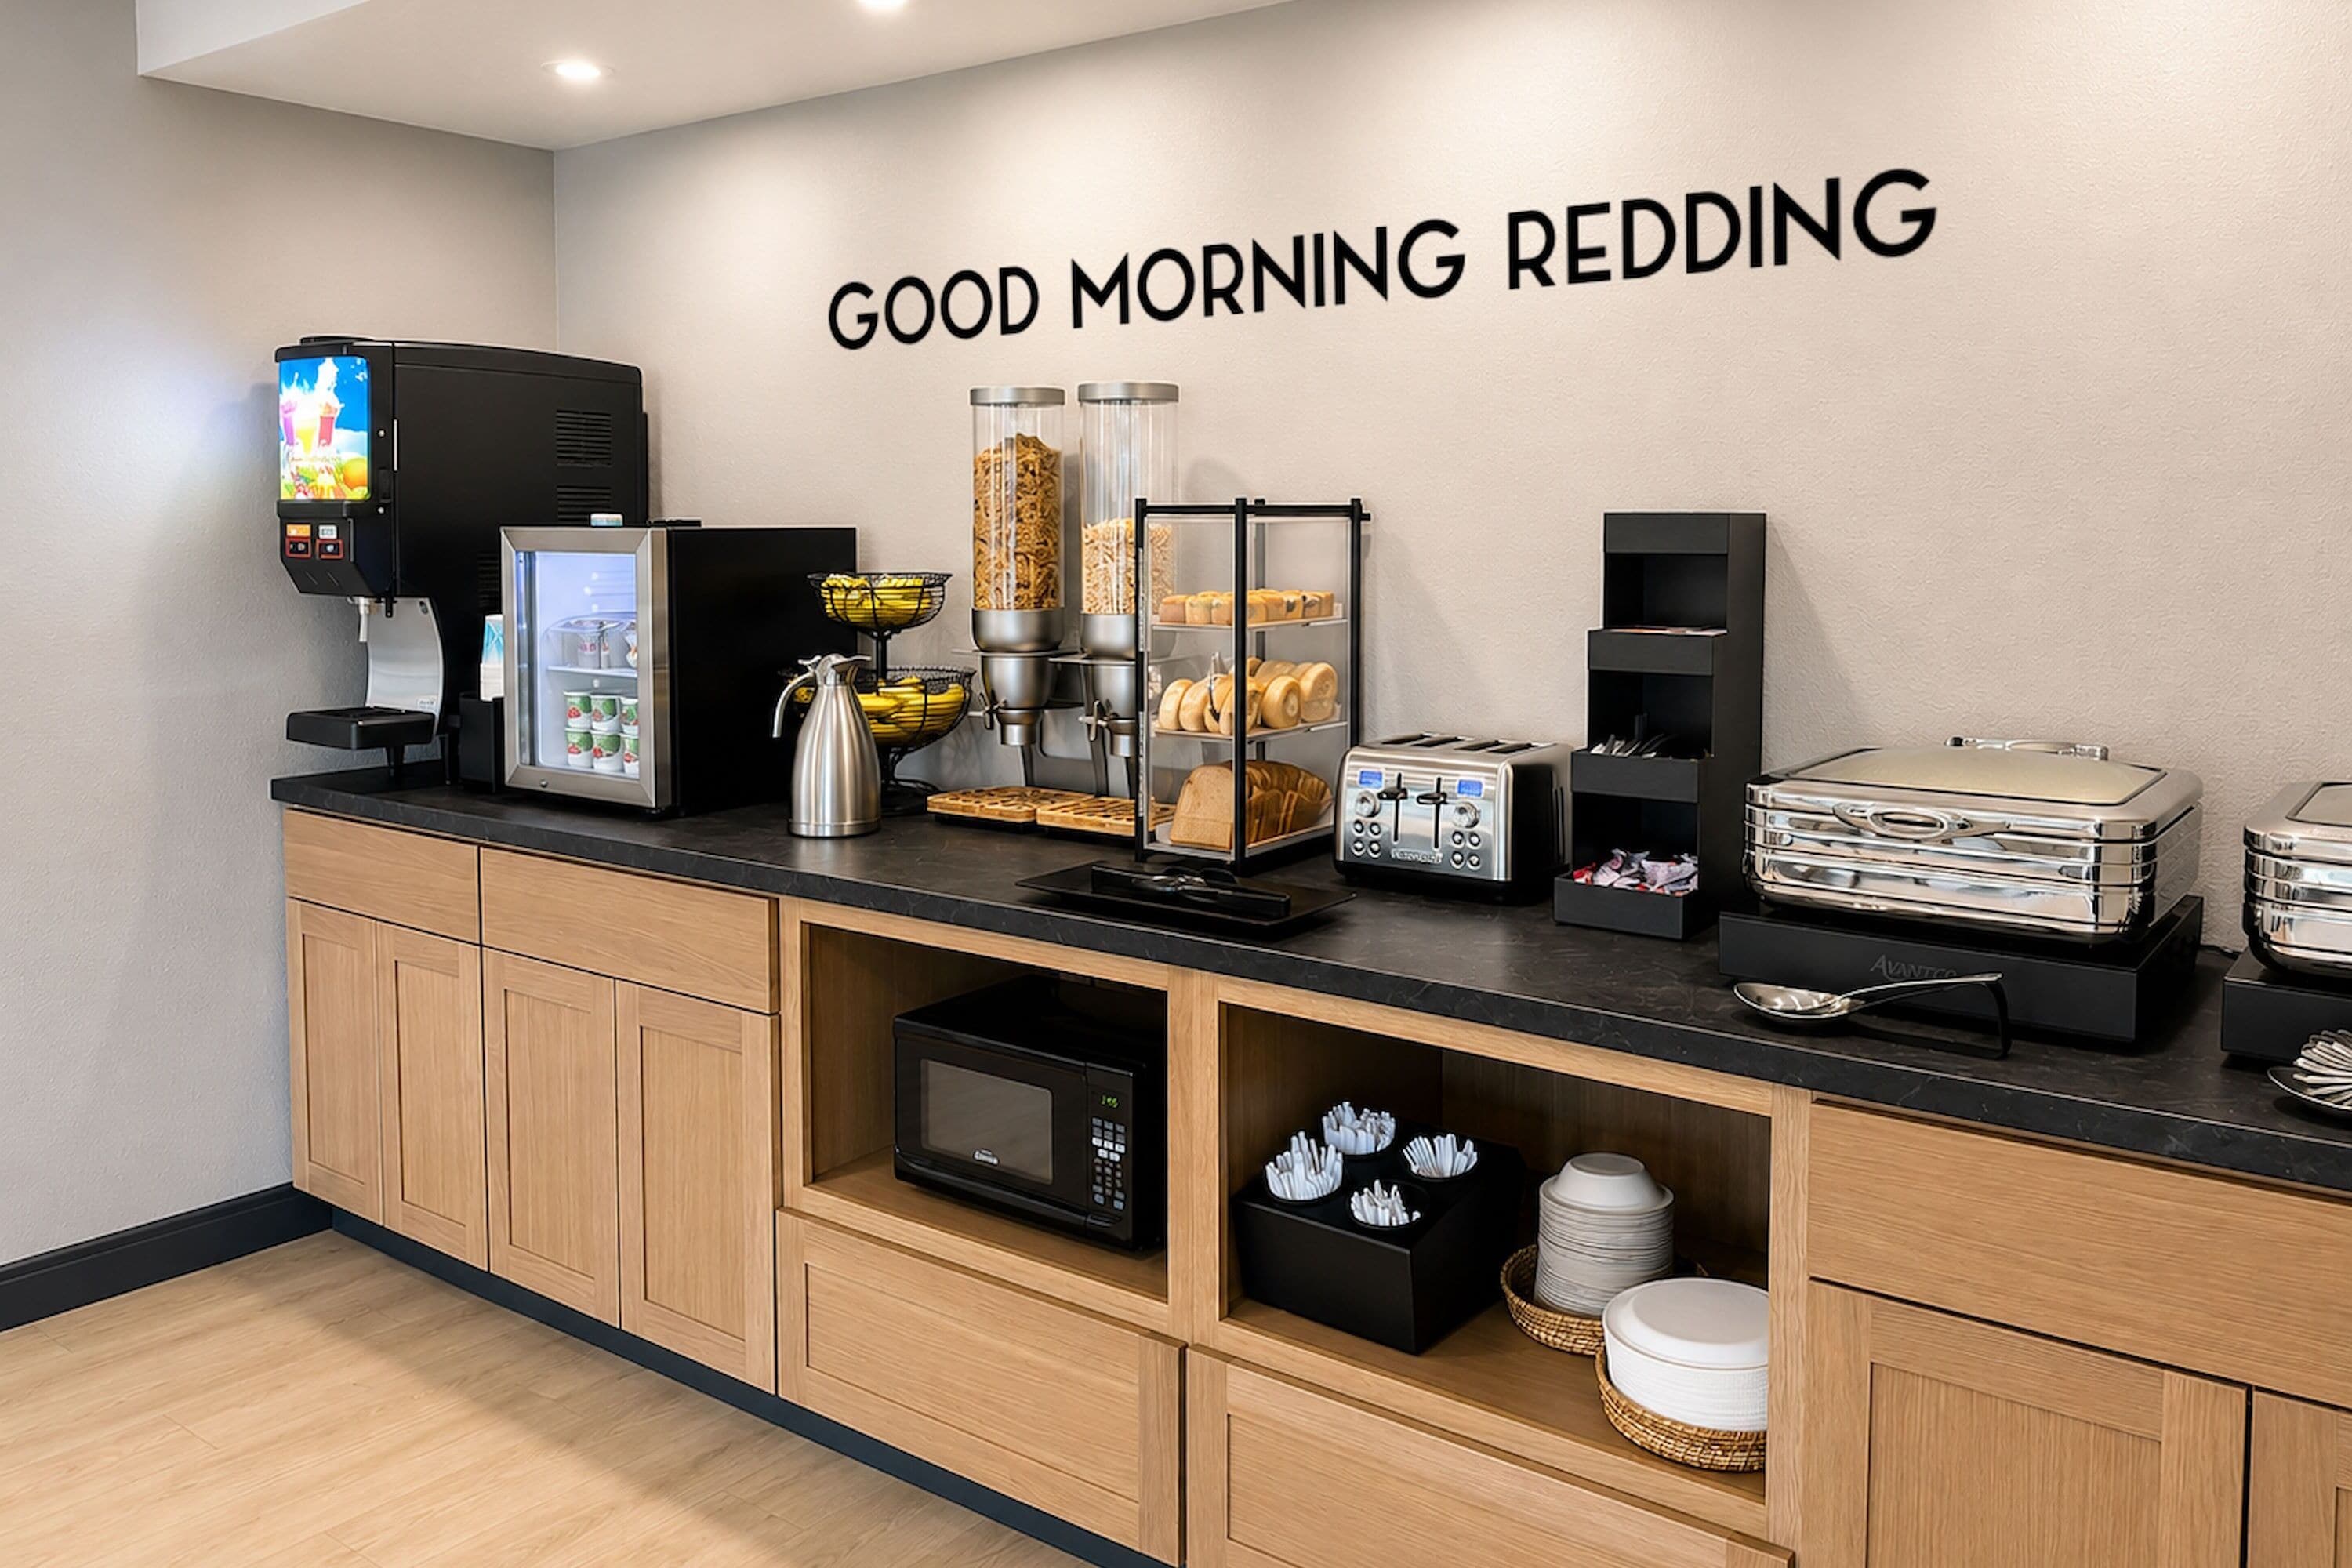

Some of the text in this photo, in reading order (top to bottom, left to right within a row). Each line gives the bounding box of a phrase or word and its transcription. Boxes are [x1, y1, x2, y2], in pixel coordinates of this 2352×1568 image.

[828, 169, 1936, 350] GOOD MORNING REDDING
